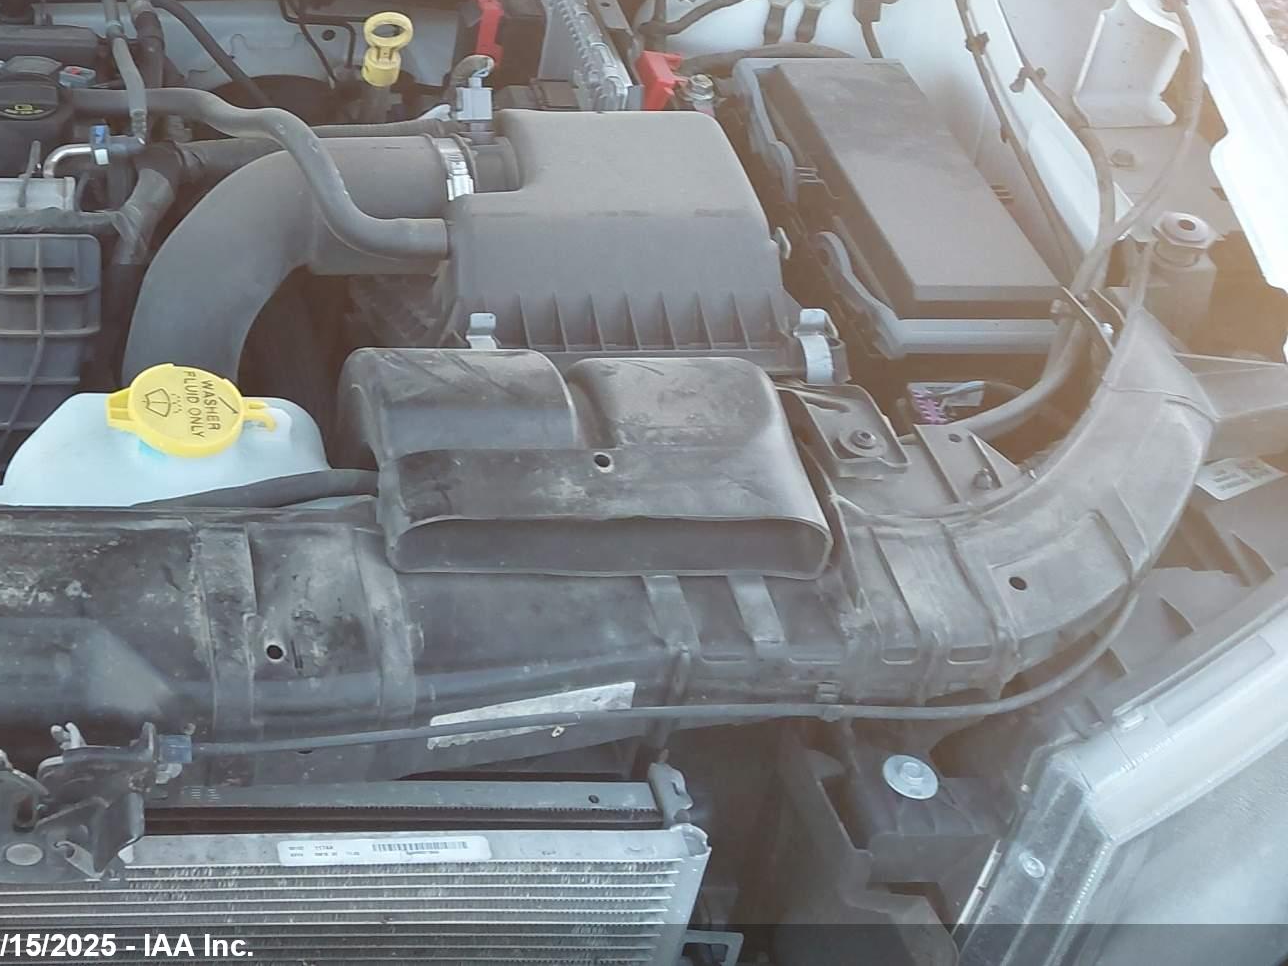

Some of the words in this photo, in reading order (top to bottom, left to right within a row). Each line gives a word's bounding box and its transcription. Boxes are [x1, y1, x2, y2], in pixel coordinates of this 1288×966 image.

[184, 371, 200, 404] FLUID
[201, 380, 222, 430] WASHER
[188, 409, 206, 438] ONLY
